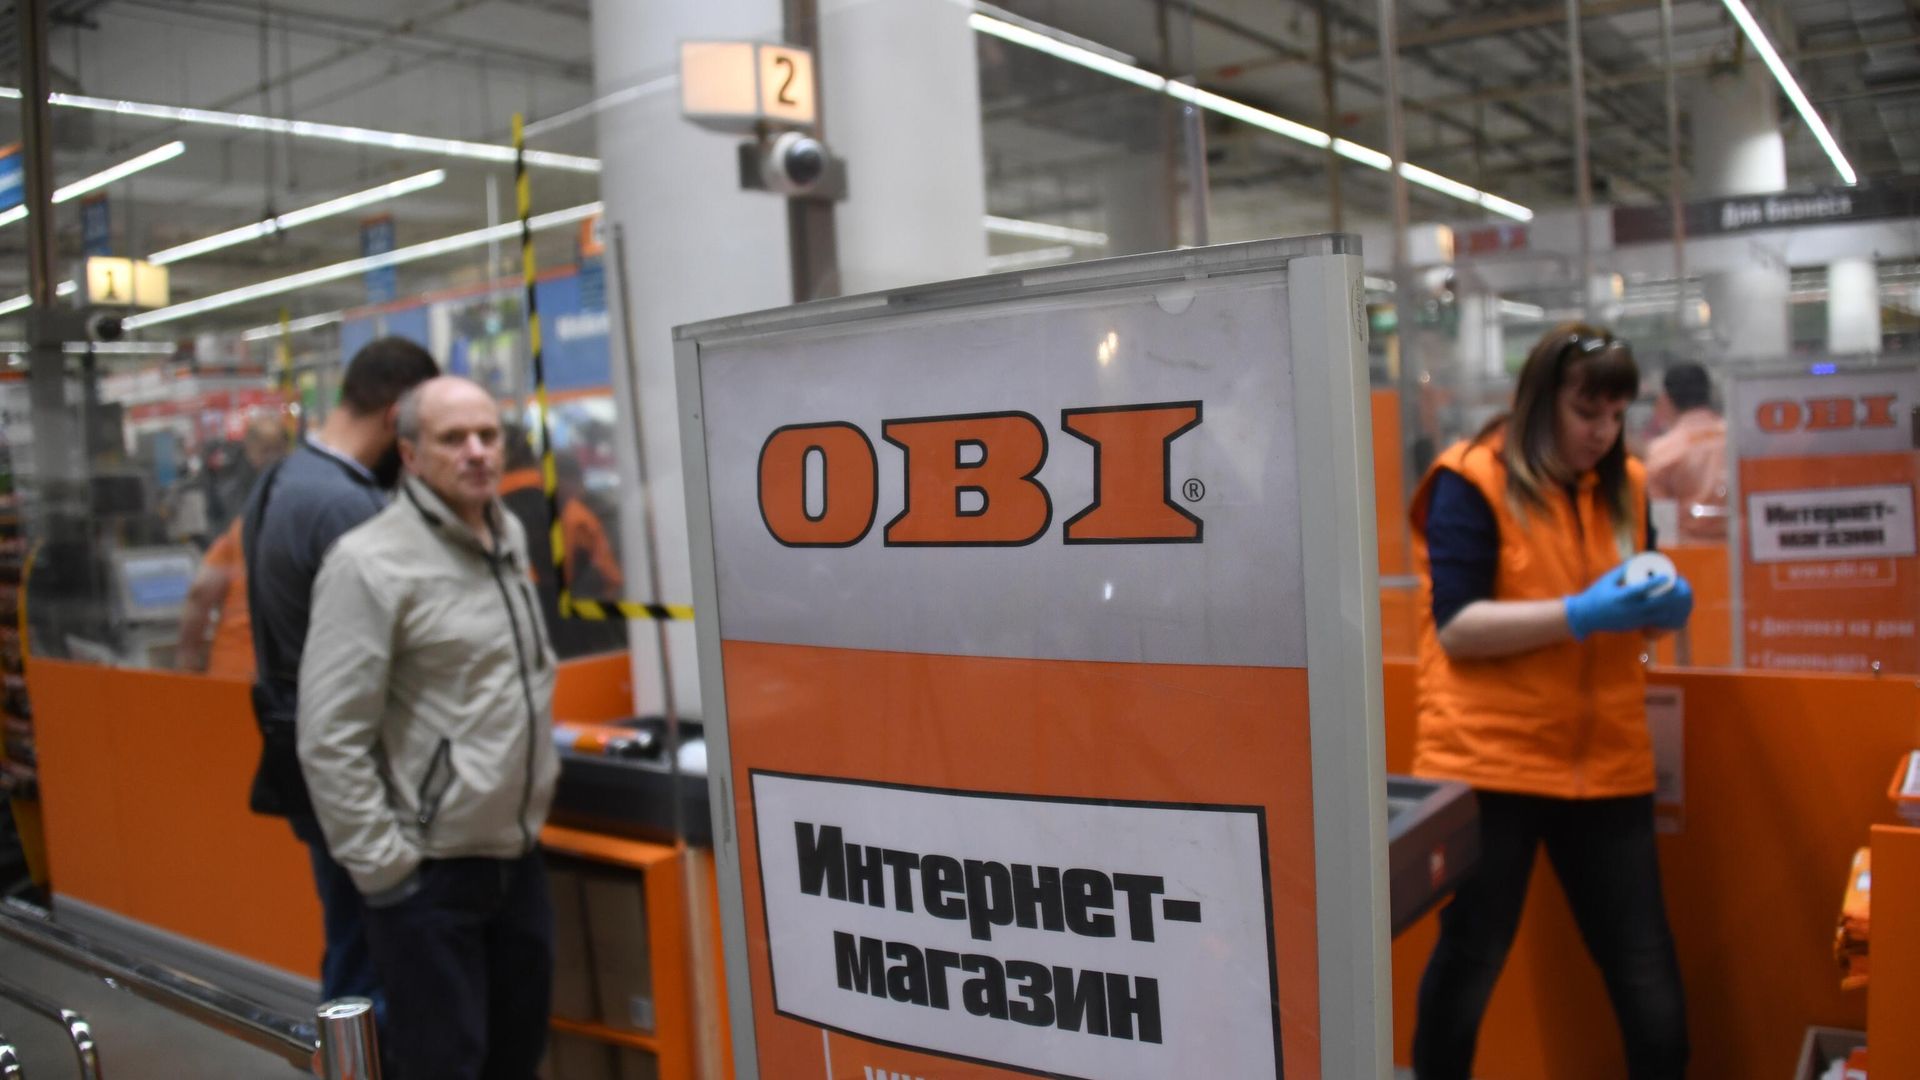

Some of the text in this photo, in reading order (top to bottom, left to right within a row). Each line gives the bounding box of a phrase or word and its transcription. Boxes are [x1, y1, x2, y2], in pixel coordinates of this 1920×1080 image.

[775, 56, 796, 106] 2
[1756, 393, 1897, 433] OBI
[757, 400, 1204, 548] OBI
[794, 821, 1202, 943] Интернет-
[833, 930, 1163, 1044] магазин
